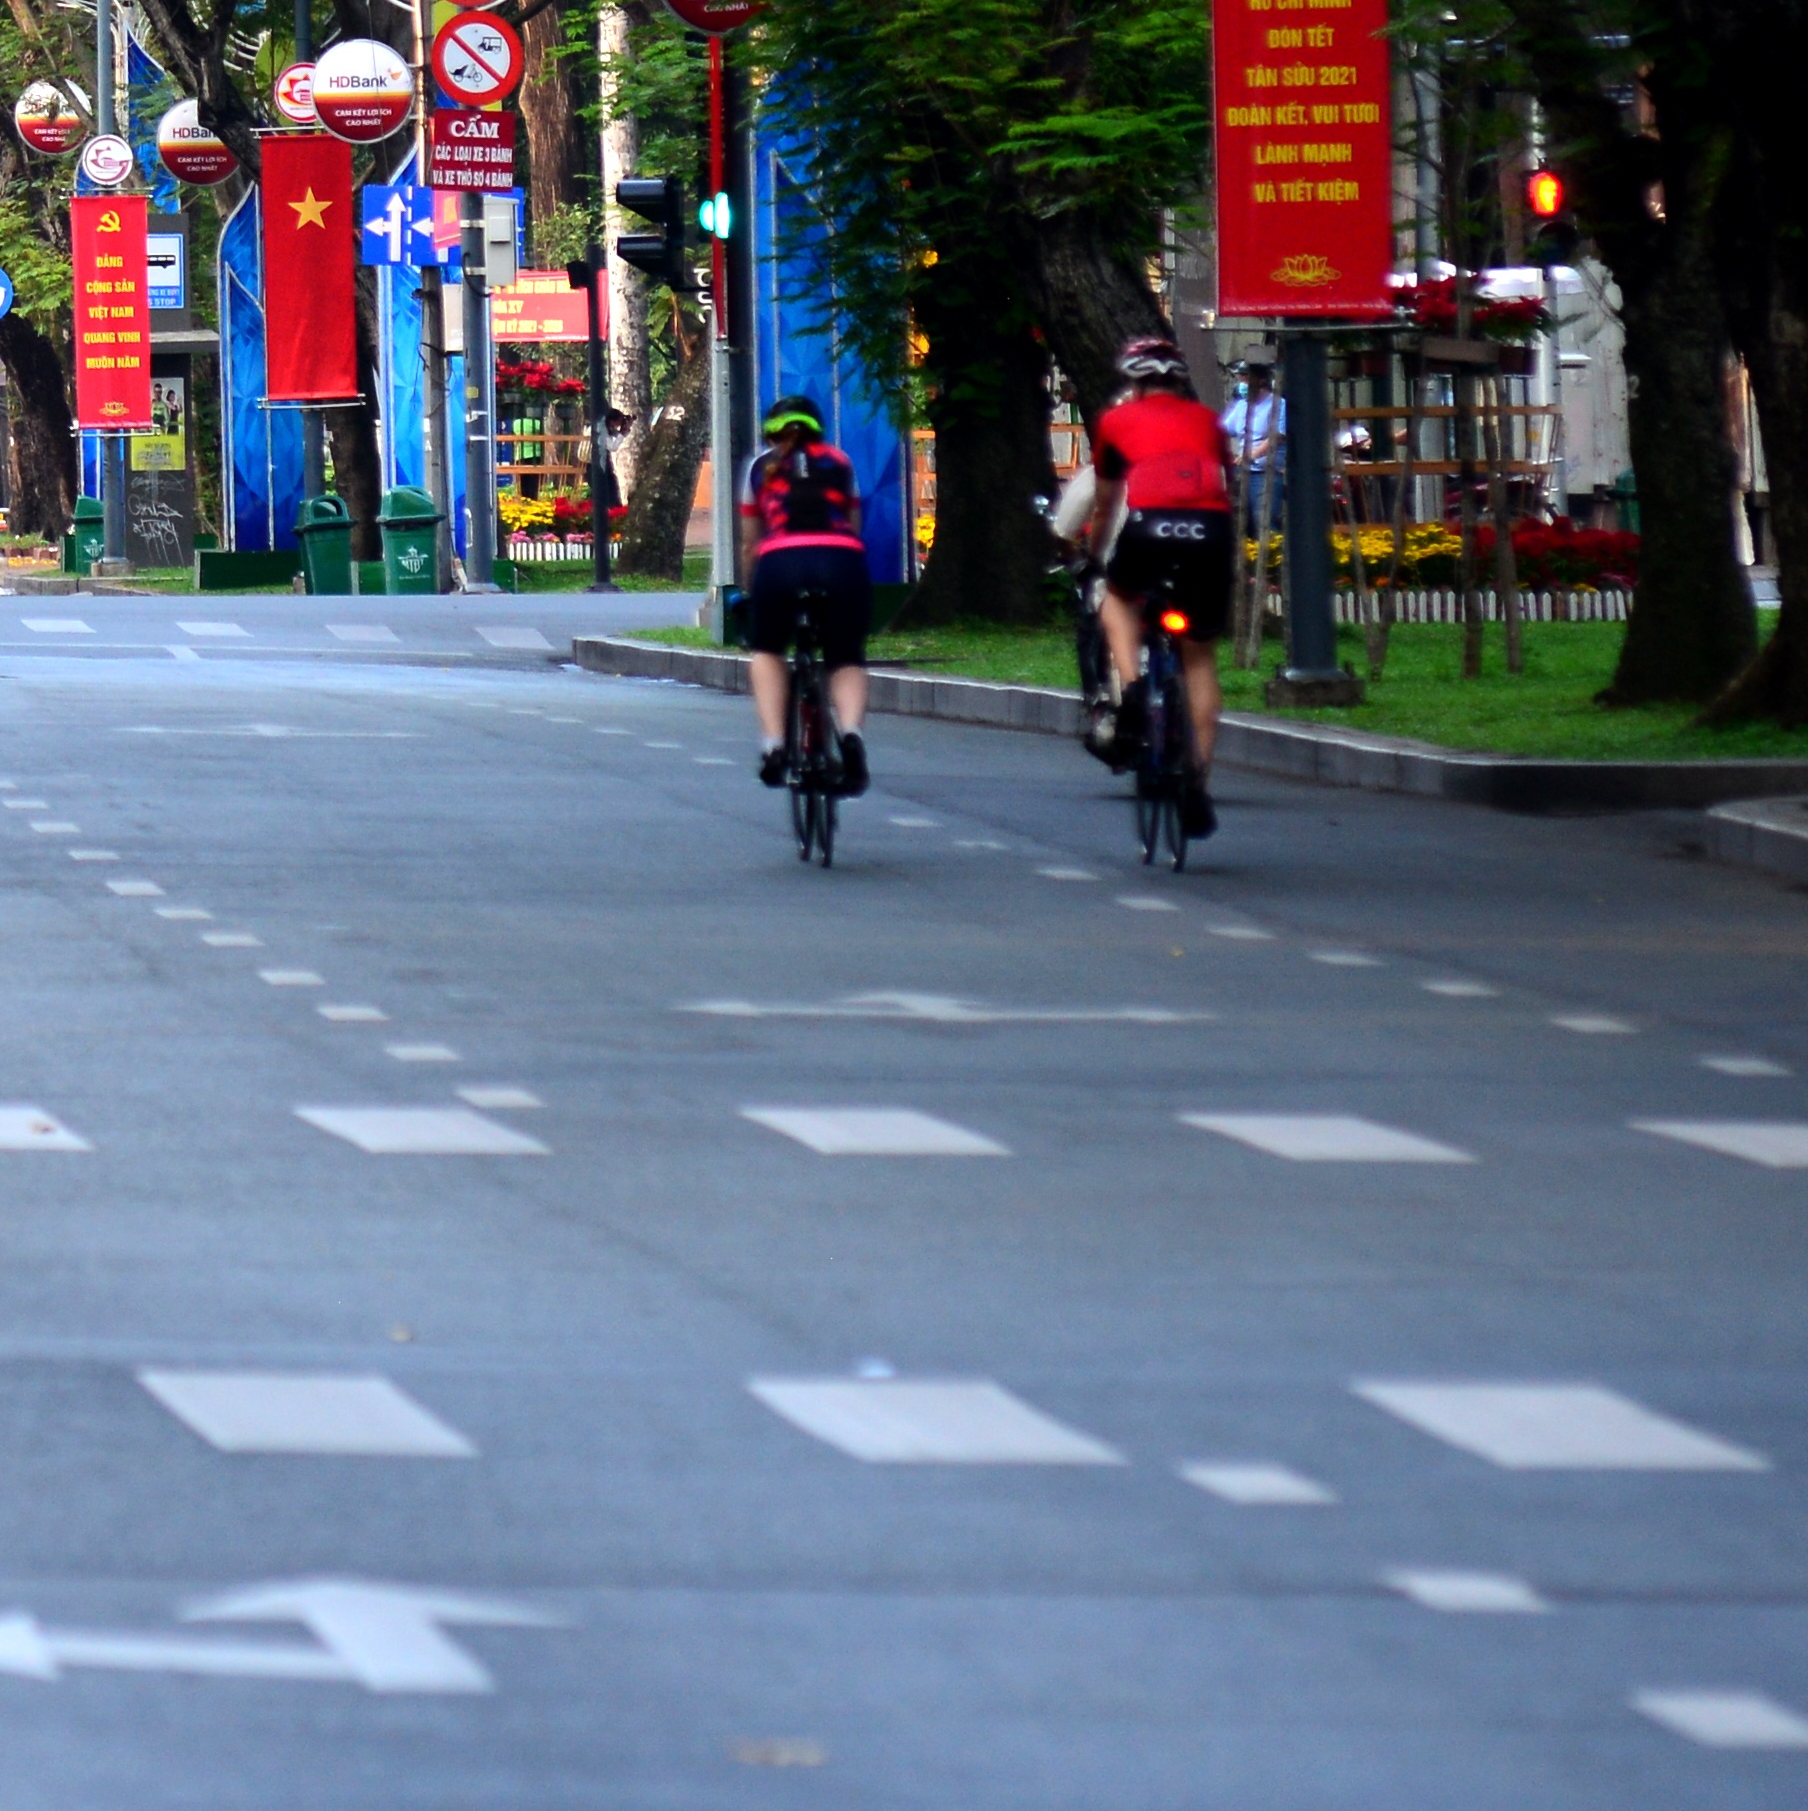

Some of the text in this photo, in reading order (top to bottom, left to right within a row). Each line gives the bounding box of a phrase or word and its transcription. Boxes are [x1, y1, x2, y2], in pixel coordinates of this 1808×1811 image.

[1307, 23, 1334, 47] TẾT
[329, 75, 387, 88] HDBank
[1246, 64, 1278, 87] TÂN
[1319, 66, 1357, 86] 2021
[1226, 102, 1272, 126] ĐOÀN
[1312, 103, 1339, 124] VUI
[173, 127, 216, 138] HDBan
[451, 114, 499, 138] CẤM
[435, 142, 451, 161] CÁC
[473, 146, 483, 161] XE
[491, 144, 513, 163] BÁNH
[1255, 141, 1352, 167] LÀNH MẠNH
[433, 166, 443, 185] VÀ
[445, 170, 455, 185] XE
[491, 168, 513, 187] BÁNH
[1254, 180, 1276, 203] VÀ
[96, 253, 123, 267] ĐẢNG
[86, 278, 135, 295] CỘNG SẢN
[154, 298, 176, 306] STOP
[89, 305, 134, 320] VIỆT NAM
[84, 331, 141, 344] QUANG VINH
[86, 355, 140, 369] MUÔN NĂM
[1156, 521, 1205, 540] CCC
